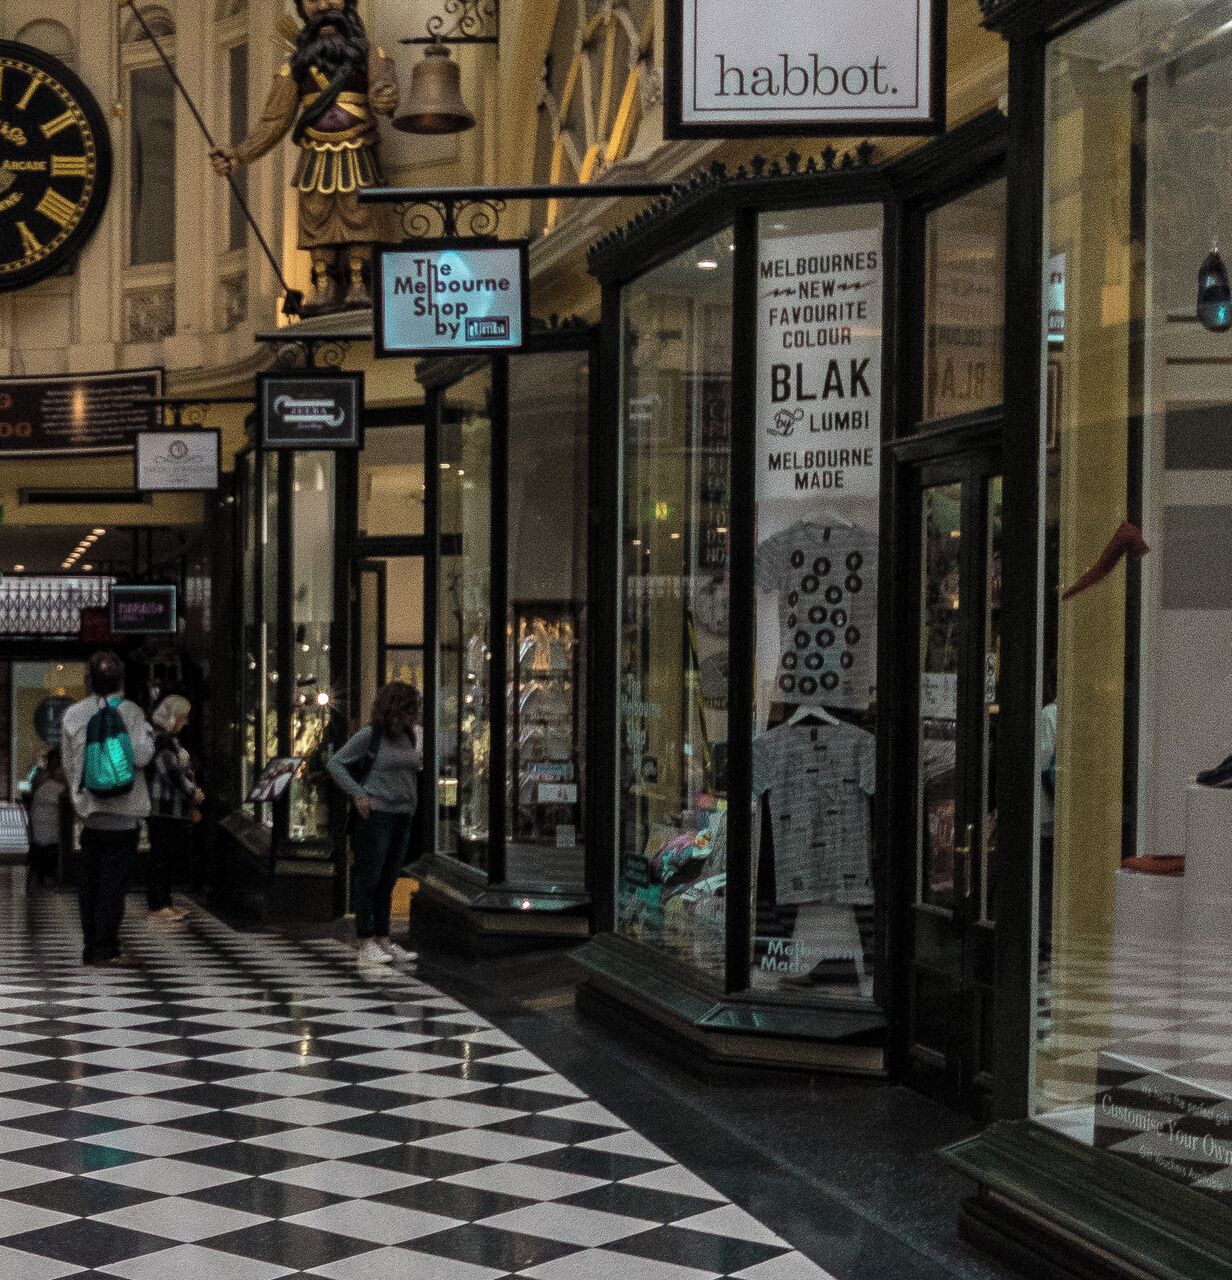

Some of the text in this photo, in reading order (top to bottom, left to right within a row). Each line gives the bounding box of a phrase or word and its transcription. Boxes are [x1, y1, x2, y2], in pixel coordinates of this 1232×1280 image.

[715, 53, 899, 97] habbot.
[15, 77, 42, 111] I
[40, 109, 78, 139] II
[50, 154, 87, 177] III
[414, 259, 452, 282] The
[760, 251, 878, 279] MELBOURNES
[394, 276, 511, 297] Melbourne
[798, 280, 836, 300] NEW
[414, 296, 468, 321] Shop
[769, 301, 868, 327] FAVOURITE
[435, 317, 460, 339] by
[782, 326, 852, 349] COLOUR
[771, 357, 872, 404] BLAK
[810, 410, 871, 433] LUMBI
[768, 447, 874, 472] MELBOURNE
[794, 470, 845, 490] MADE
[761, 956, 811, 974] Made
[1101, 1093, 1165, 1137] Customise
[1167, 1117, 1200, 1152] Your
